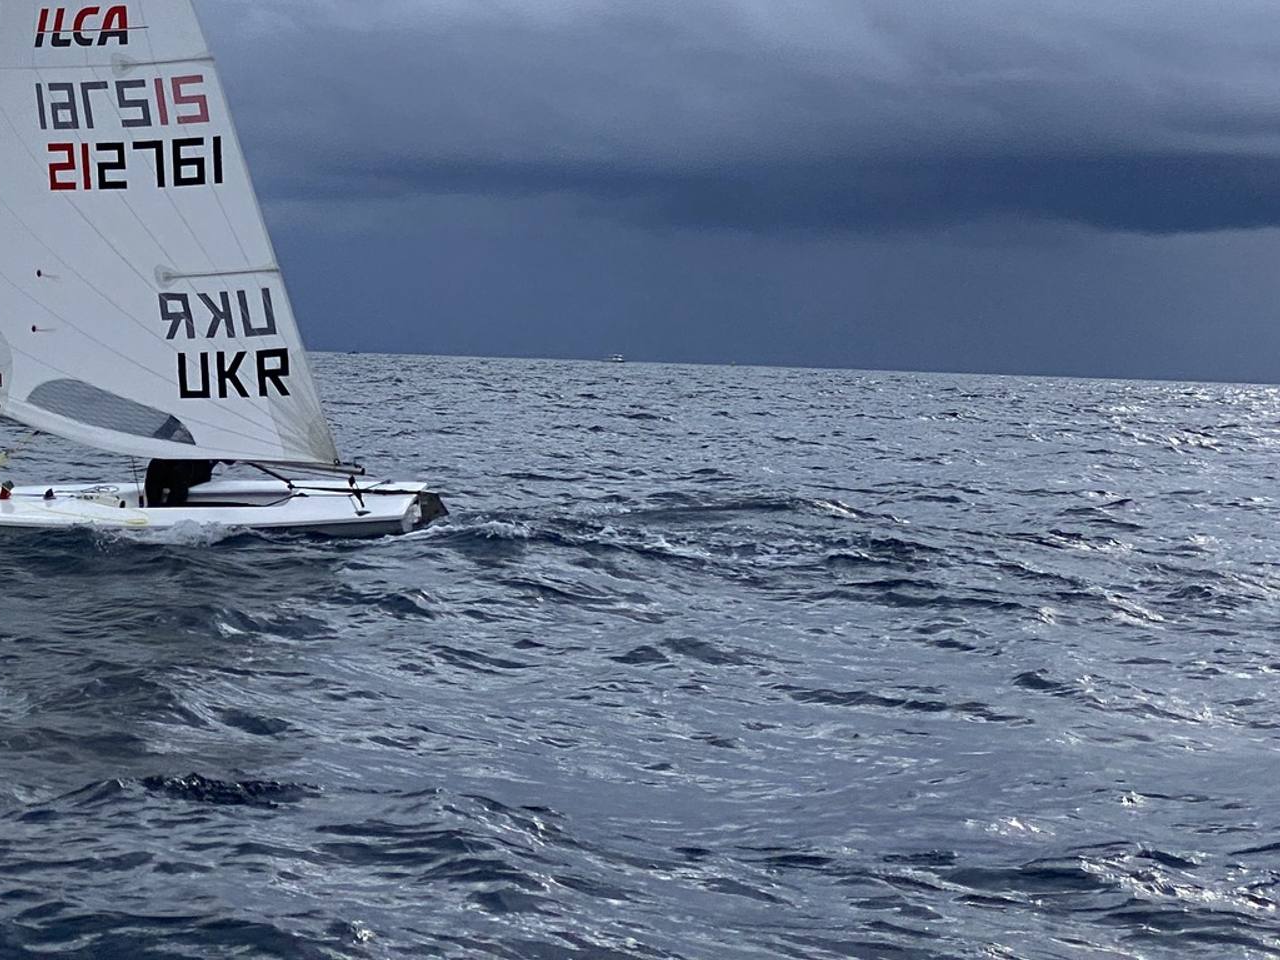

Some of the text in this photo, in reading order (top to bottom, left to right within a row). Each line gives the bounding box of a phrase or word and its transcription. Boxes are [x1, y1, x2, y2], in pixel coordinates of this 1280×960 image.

[34, 5, 129, 48] ILCA
[47, 135, 224, 191] 212761
[177, 347, 290, 399] UKR
